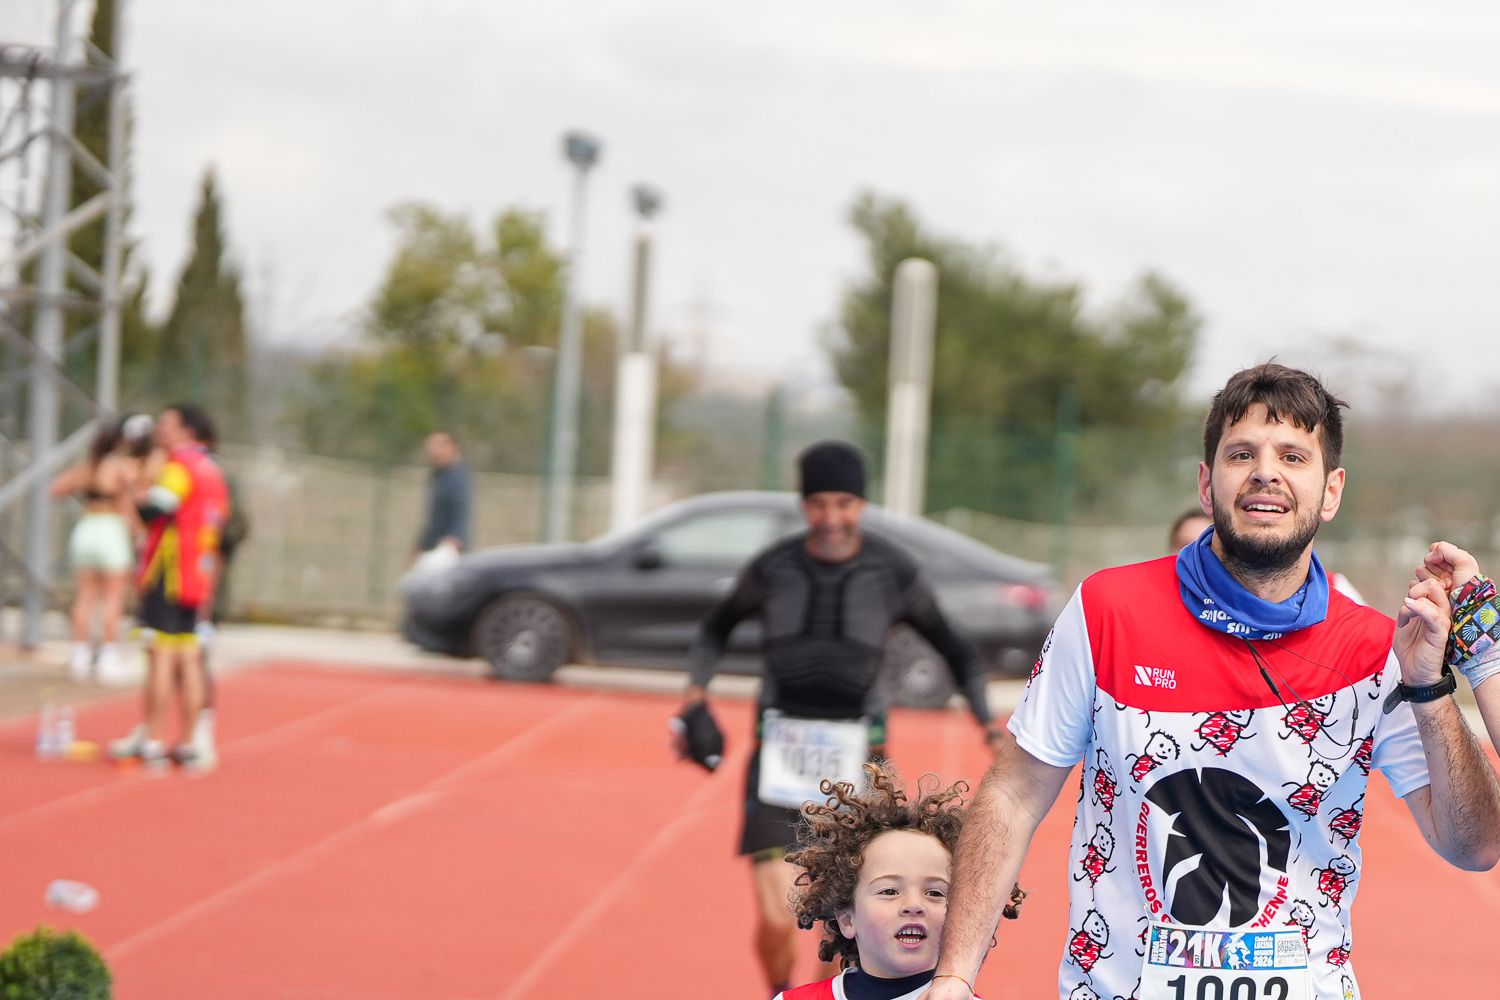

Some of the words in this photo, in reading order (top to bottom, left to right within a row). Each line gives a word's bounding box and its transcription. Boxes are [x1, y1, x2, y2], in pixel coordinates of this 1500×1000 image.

[1153, 668, 1176, 680] RUN
[1154, 677, 1177, 690] PRO
[1135, 801, 1163, 914] GUERREROS
[1250, 875, 1289, 929] HENNE
[1168, 930, 1223, 968] 21K
